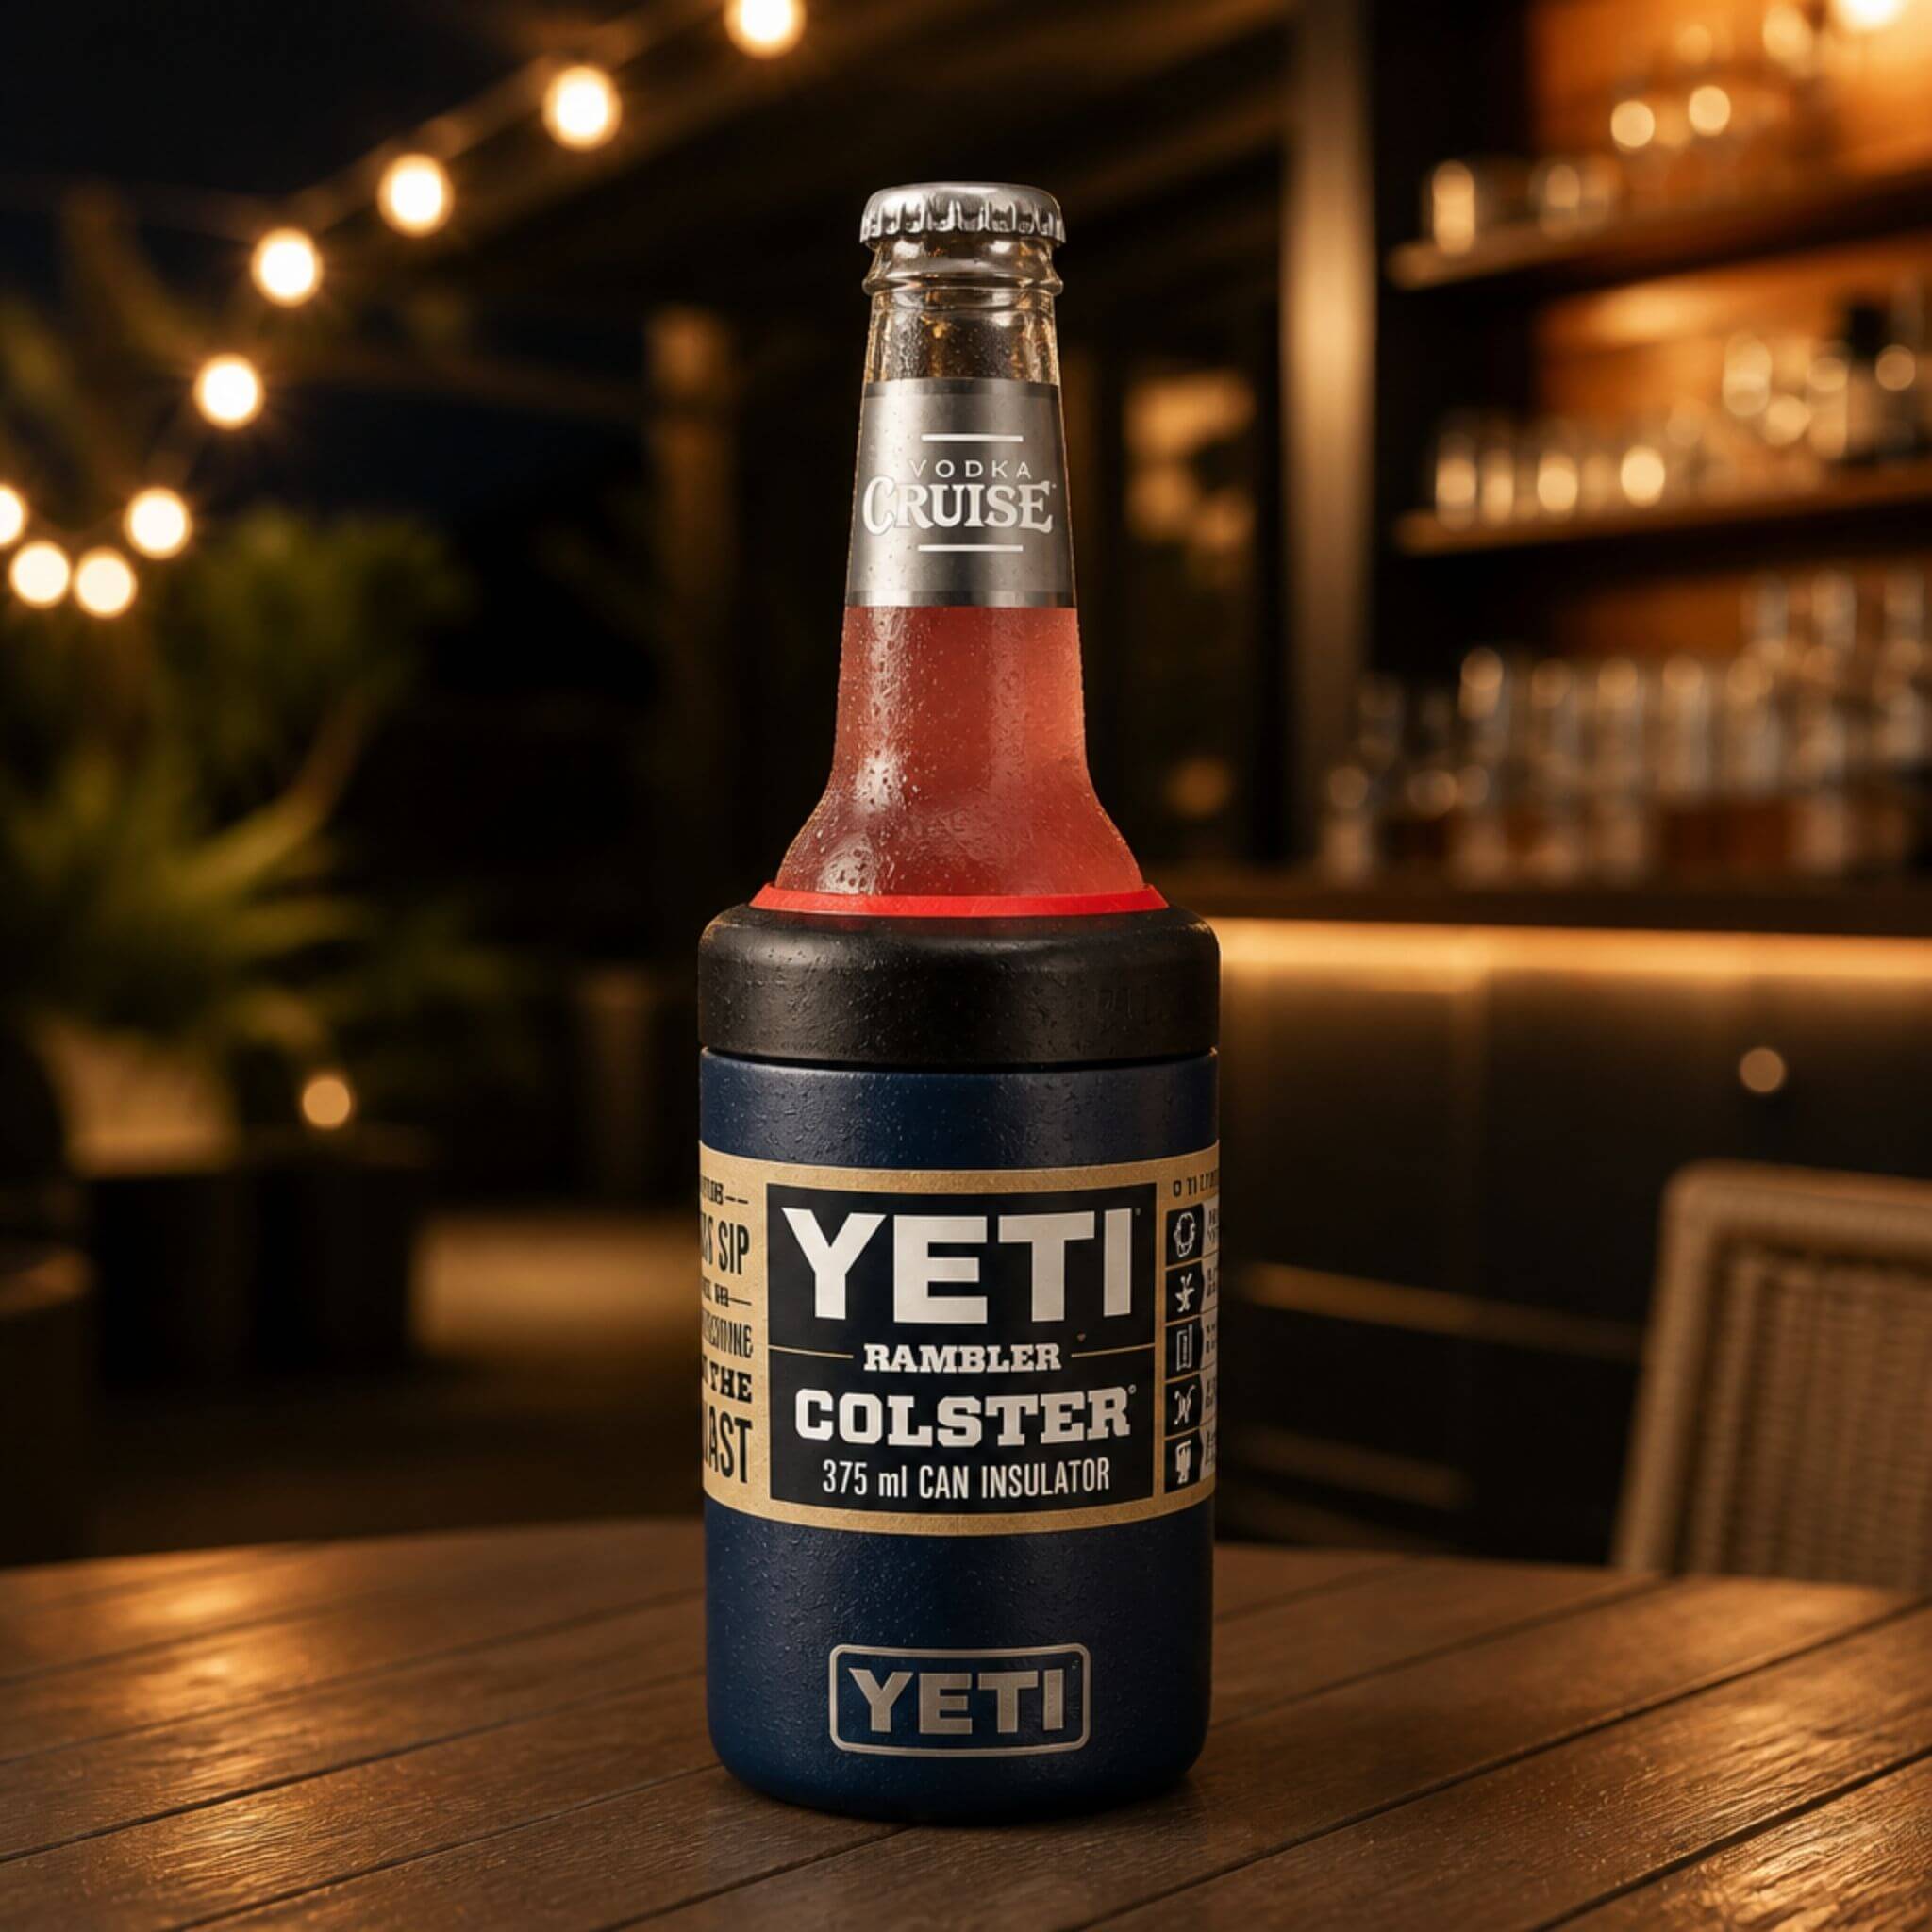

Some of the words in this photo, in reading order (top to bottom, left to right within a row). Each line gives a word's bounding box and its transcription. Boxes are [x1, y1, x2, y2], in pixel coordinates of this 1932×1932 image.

[909, 459, 1032, 478] VODKA
[862, 475, 1054, 535] CRUISE
[718, 1220, 750, 1276] SIP
[781, 1207, 1132, 1324] YETI
[863, 1343, 1062, 1374] RAMBLER
[794, 1386, 1131, 1447] COLSTER
[822, 1458, 868, 1496] 375
[878, 1464, 908, 1498] ml
[919, 1464, 969, 1499] CAN
[981, 1457, 1110, 1499] INSULATOR
[849, 1667, 1064, 1734] YETI
